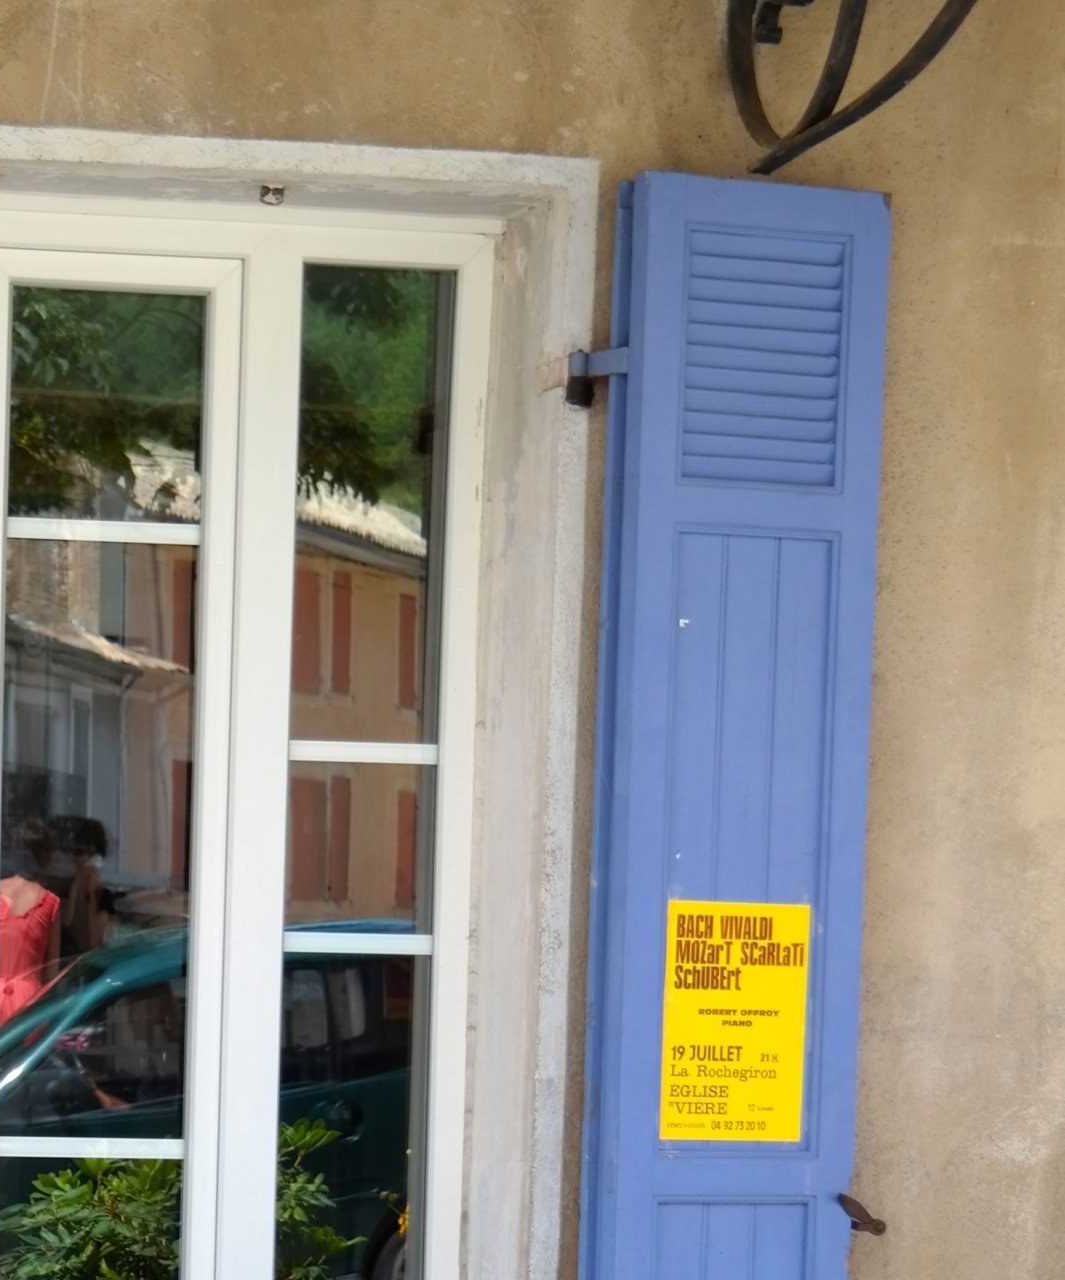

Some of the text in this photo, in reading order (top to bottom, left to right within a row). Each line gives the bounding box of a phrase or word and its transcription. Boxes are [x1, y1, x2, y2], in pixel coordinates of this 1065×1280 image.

[676, 914, 773, 941] BACH VIVALDI
[698, 1008, 779, 1017] ROBERT OFFROY
[671, 1045, 685, 1061] 19
[689, 1045, 743, 1062] JUILLET
[760, 1053, 769, 1062] 21
[670, 1064, 777, 1082] La Rochegiron
[711, 1120, 721, 1130] 04
[723, 1120, 733, 1130] 92
[745, 1121, 755, 1130] 20
[756, 1121, 766, 1131] 10
